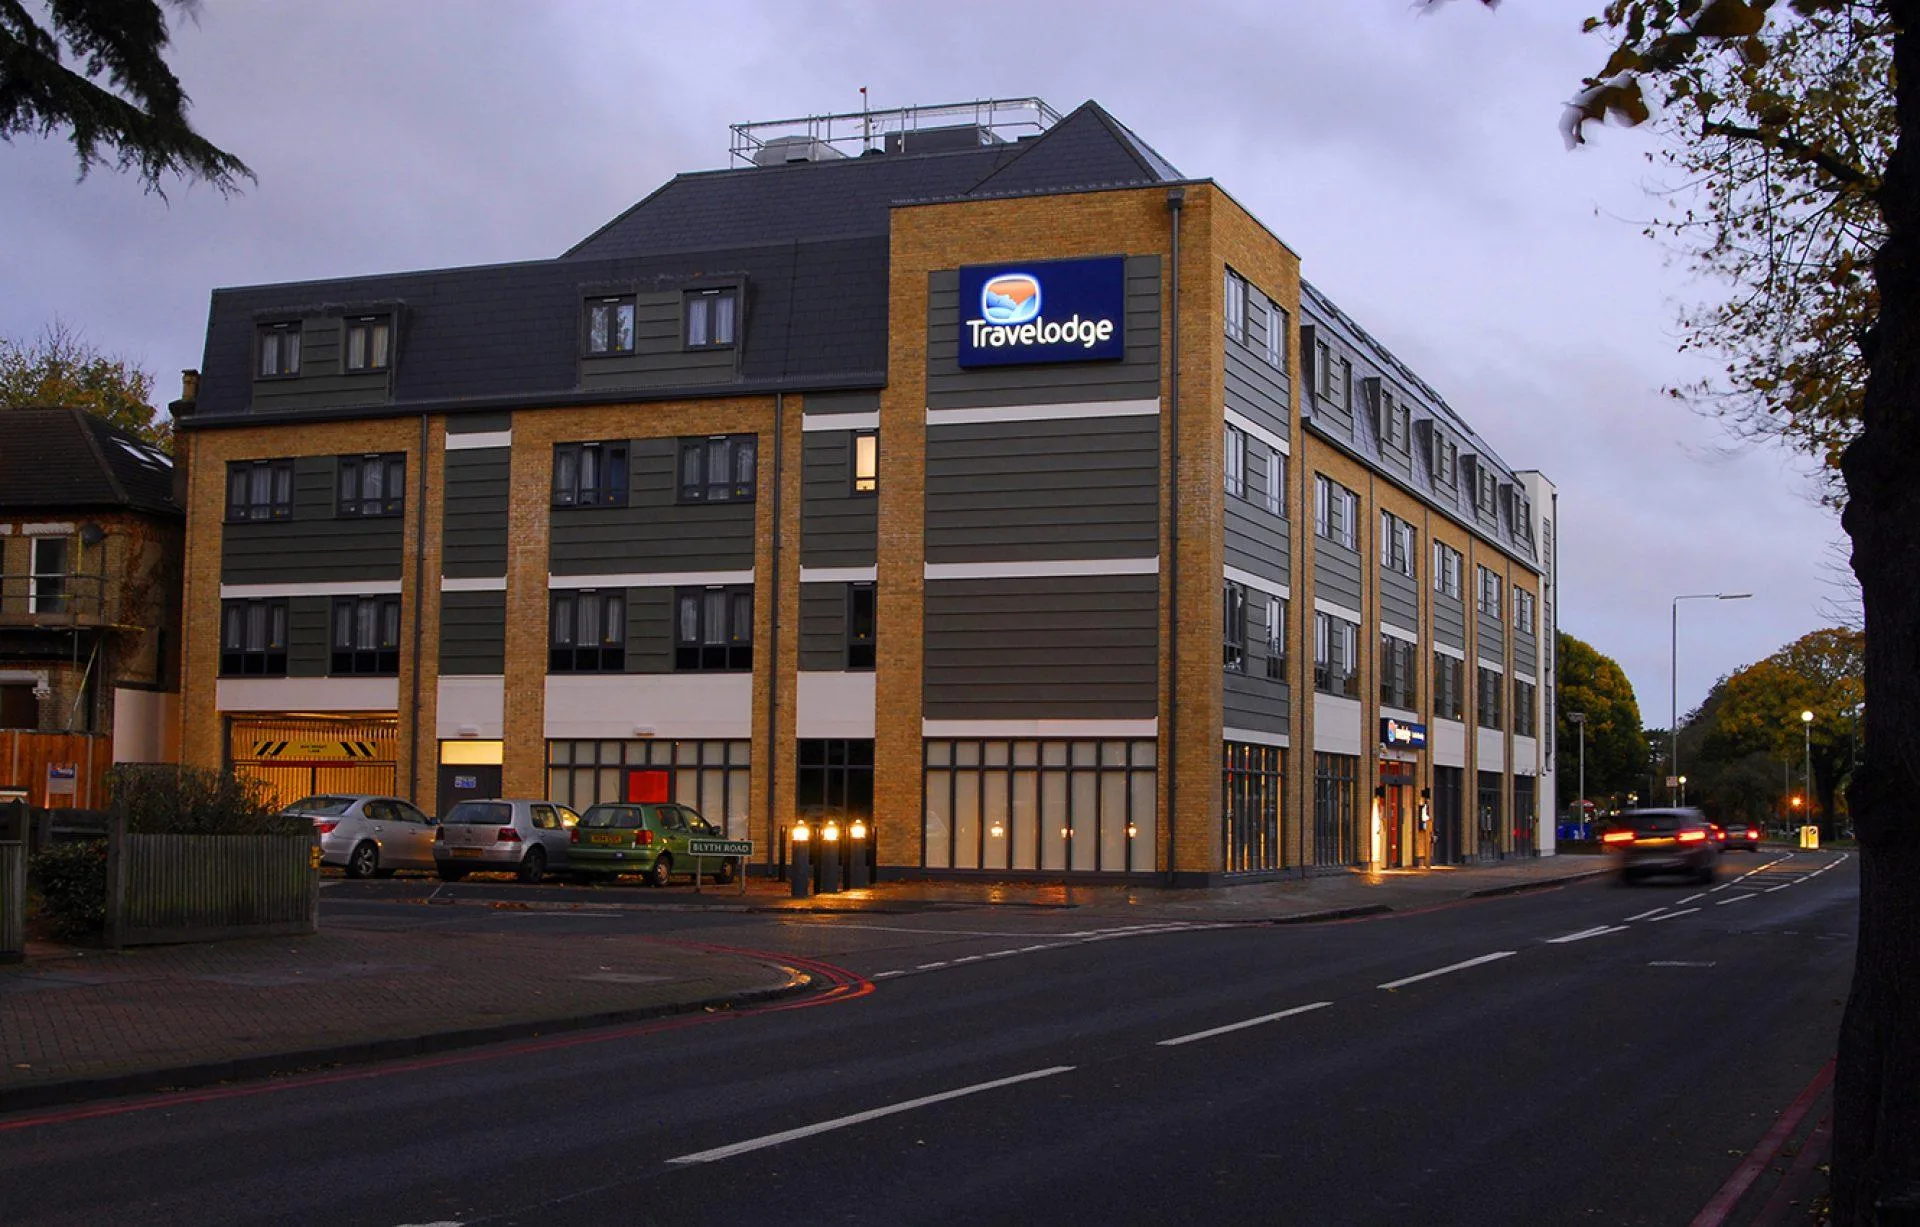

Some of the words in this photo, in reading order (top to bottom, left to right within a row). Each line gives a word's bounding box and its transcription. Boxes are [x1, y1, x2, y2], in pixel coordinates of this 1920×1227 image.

[966, 314, 1113, 348] Travelodge
[692, 843, 721, 852] BLYTH
[724, 844, 749, 853] ROAD
